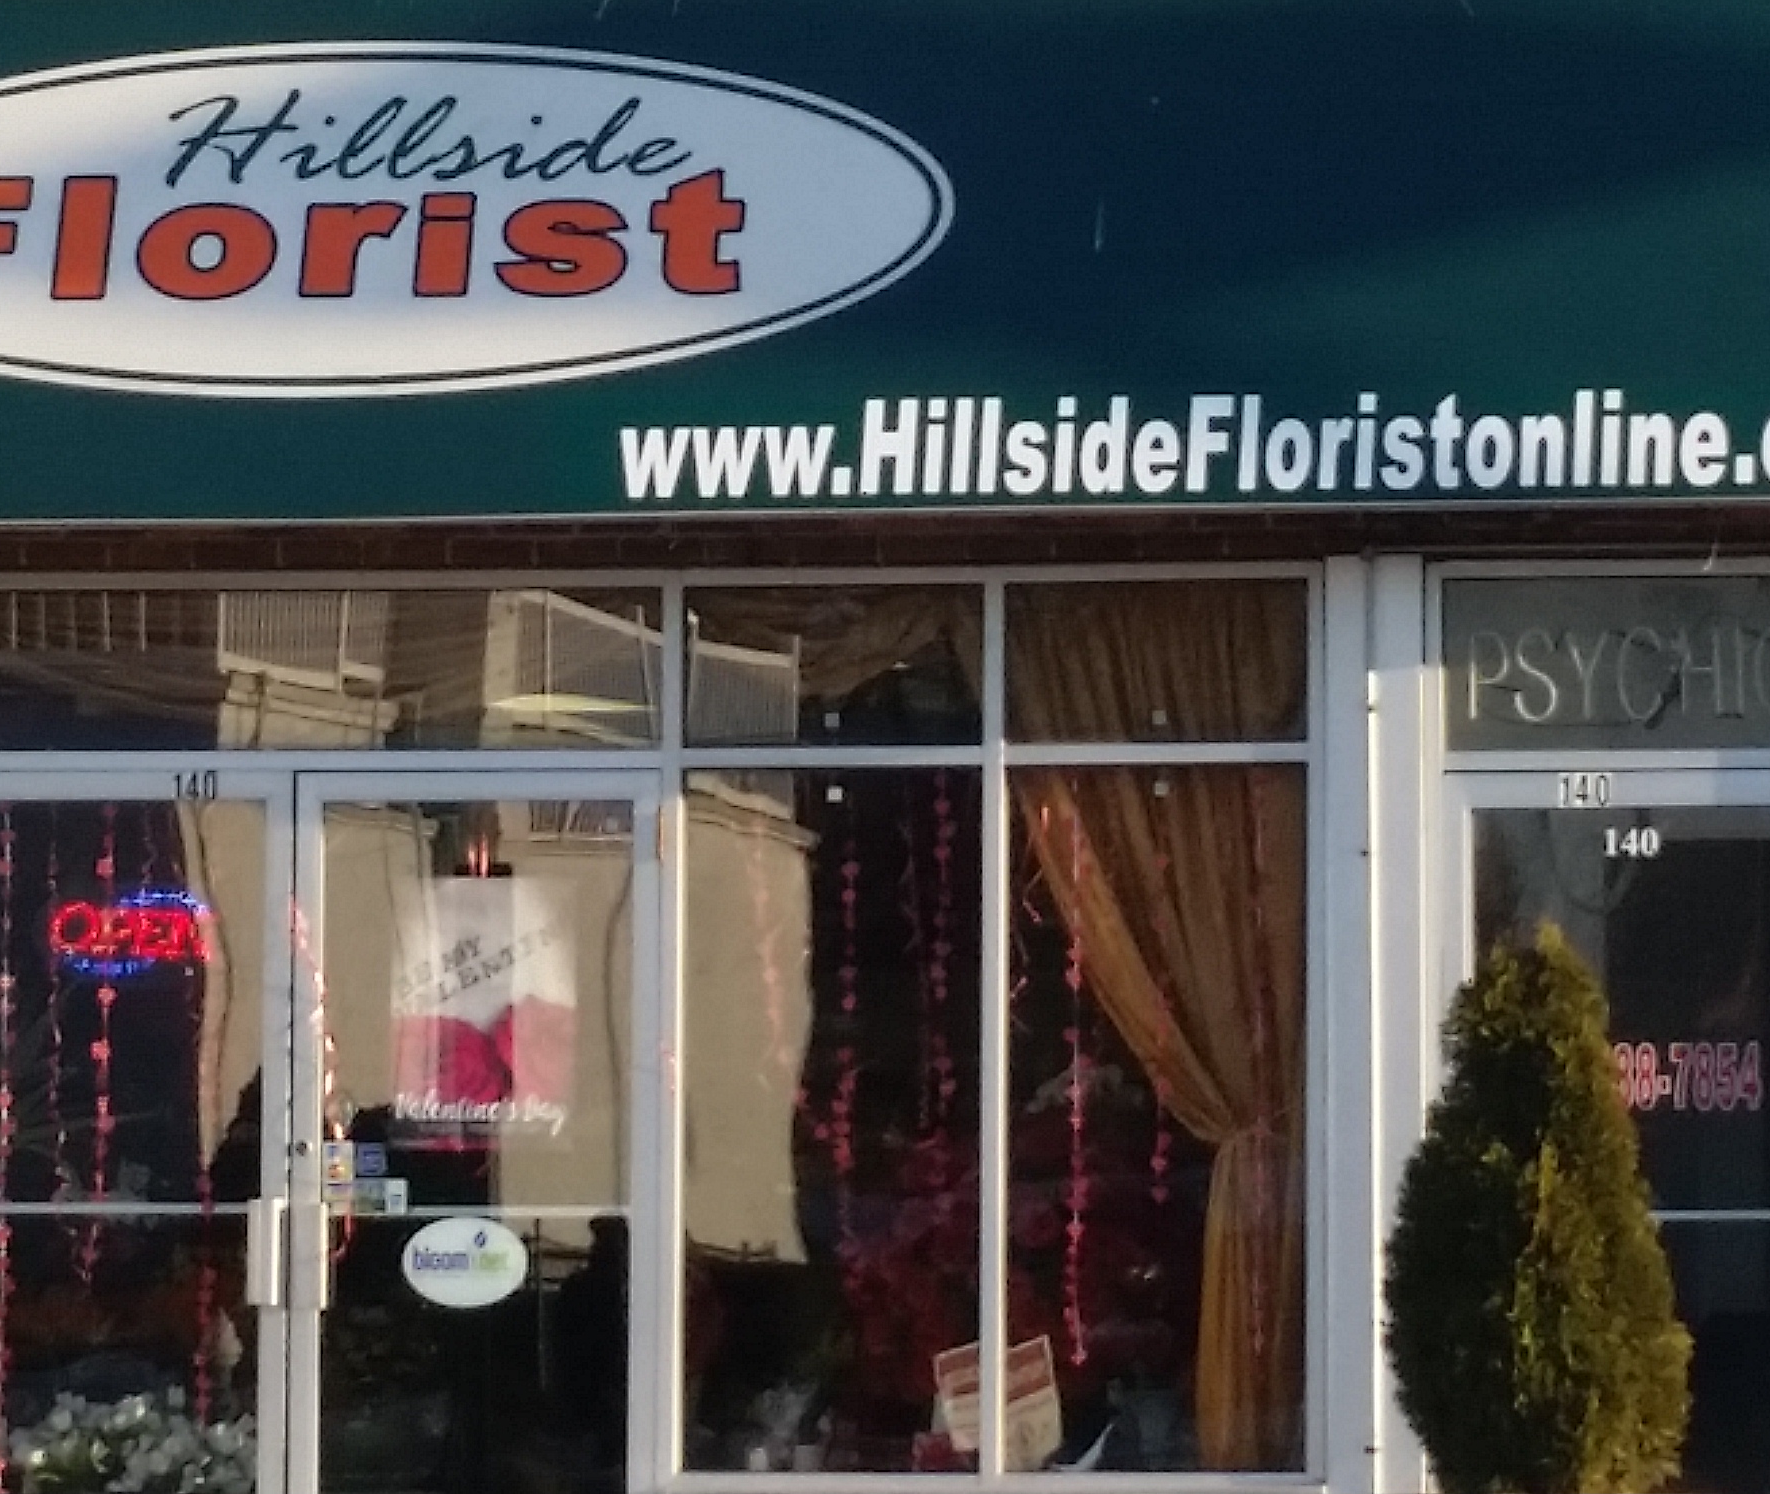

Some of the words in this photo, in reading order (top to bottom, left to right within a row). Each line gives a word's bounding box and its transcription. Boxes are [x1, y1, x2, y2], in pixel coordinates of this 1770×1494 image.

[166, 88, 695, 192] Hillside
[175, 770, 218, 800] 140
[1558, 772, 1612, 807] 140
[1603, 826, 1662, 858] 140
